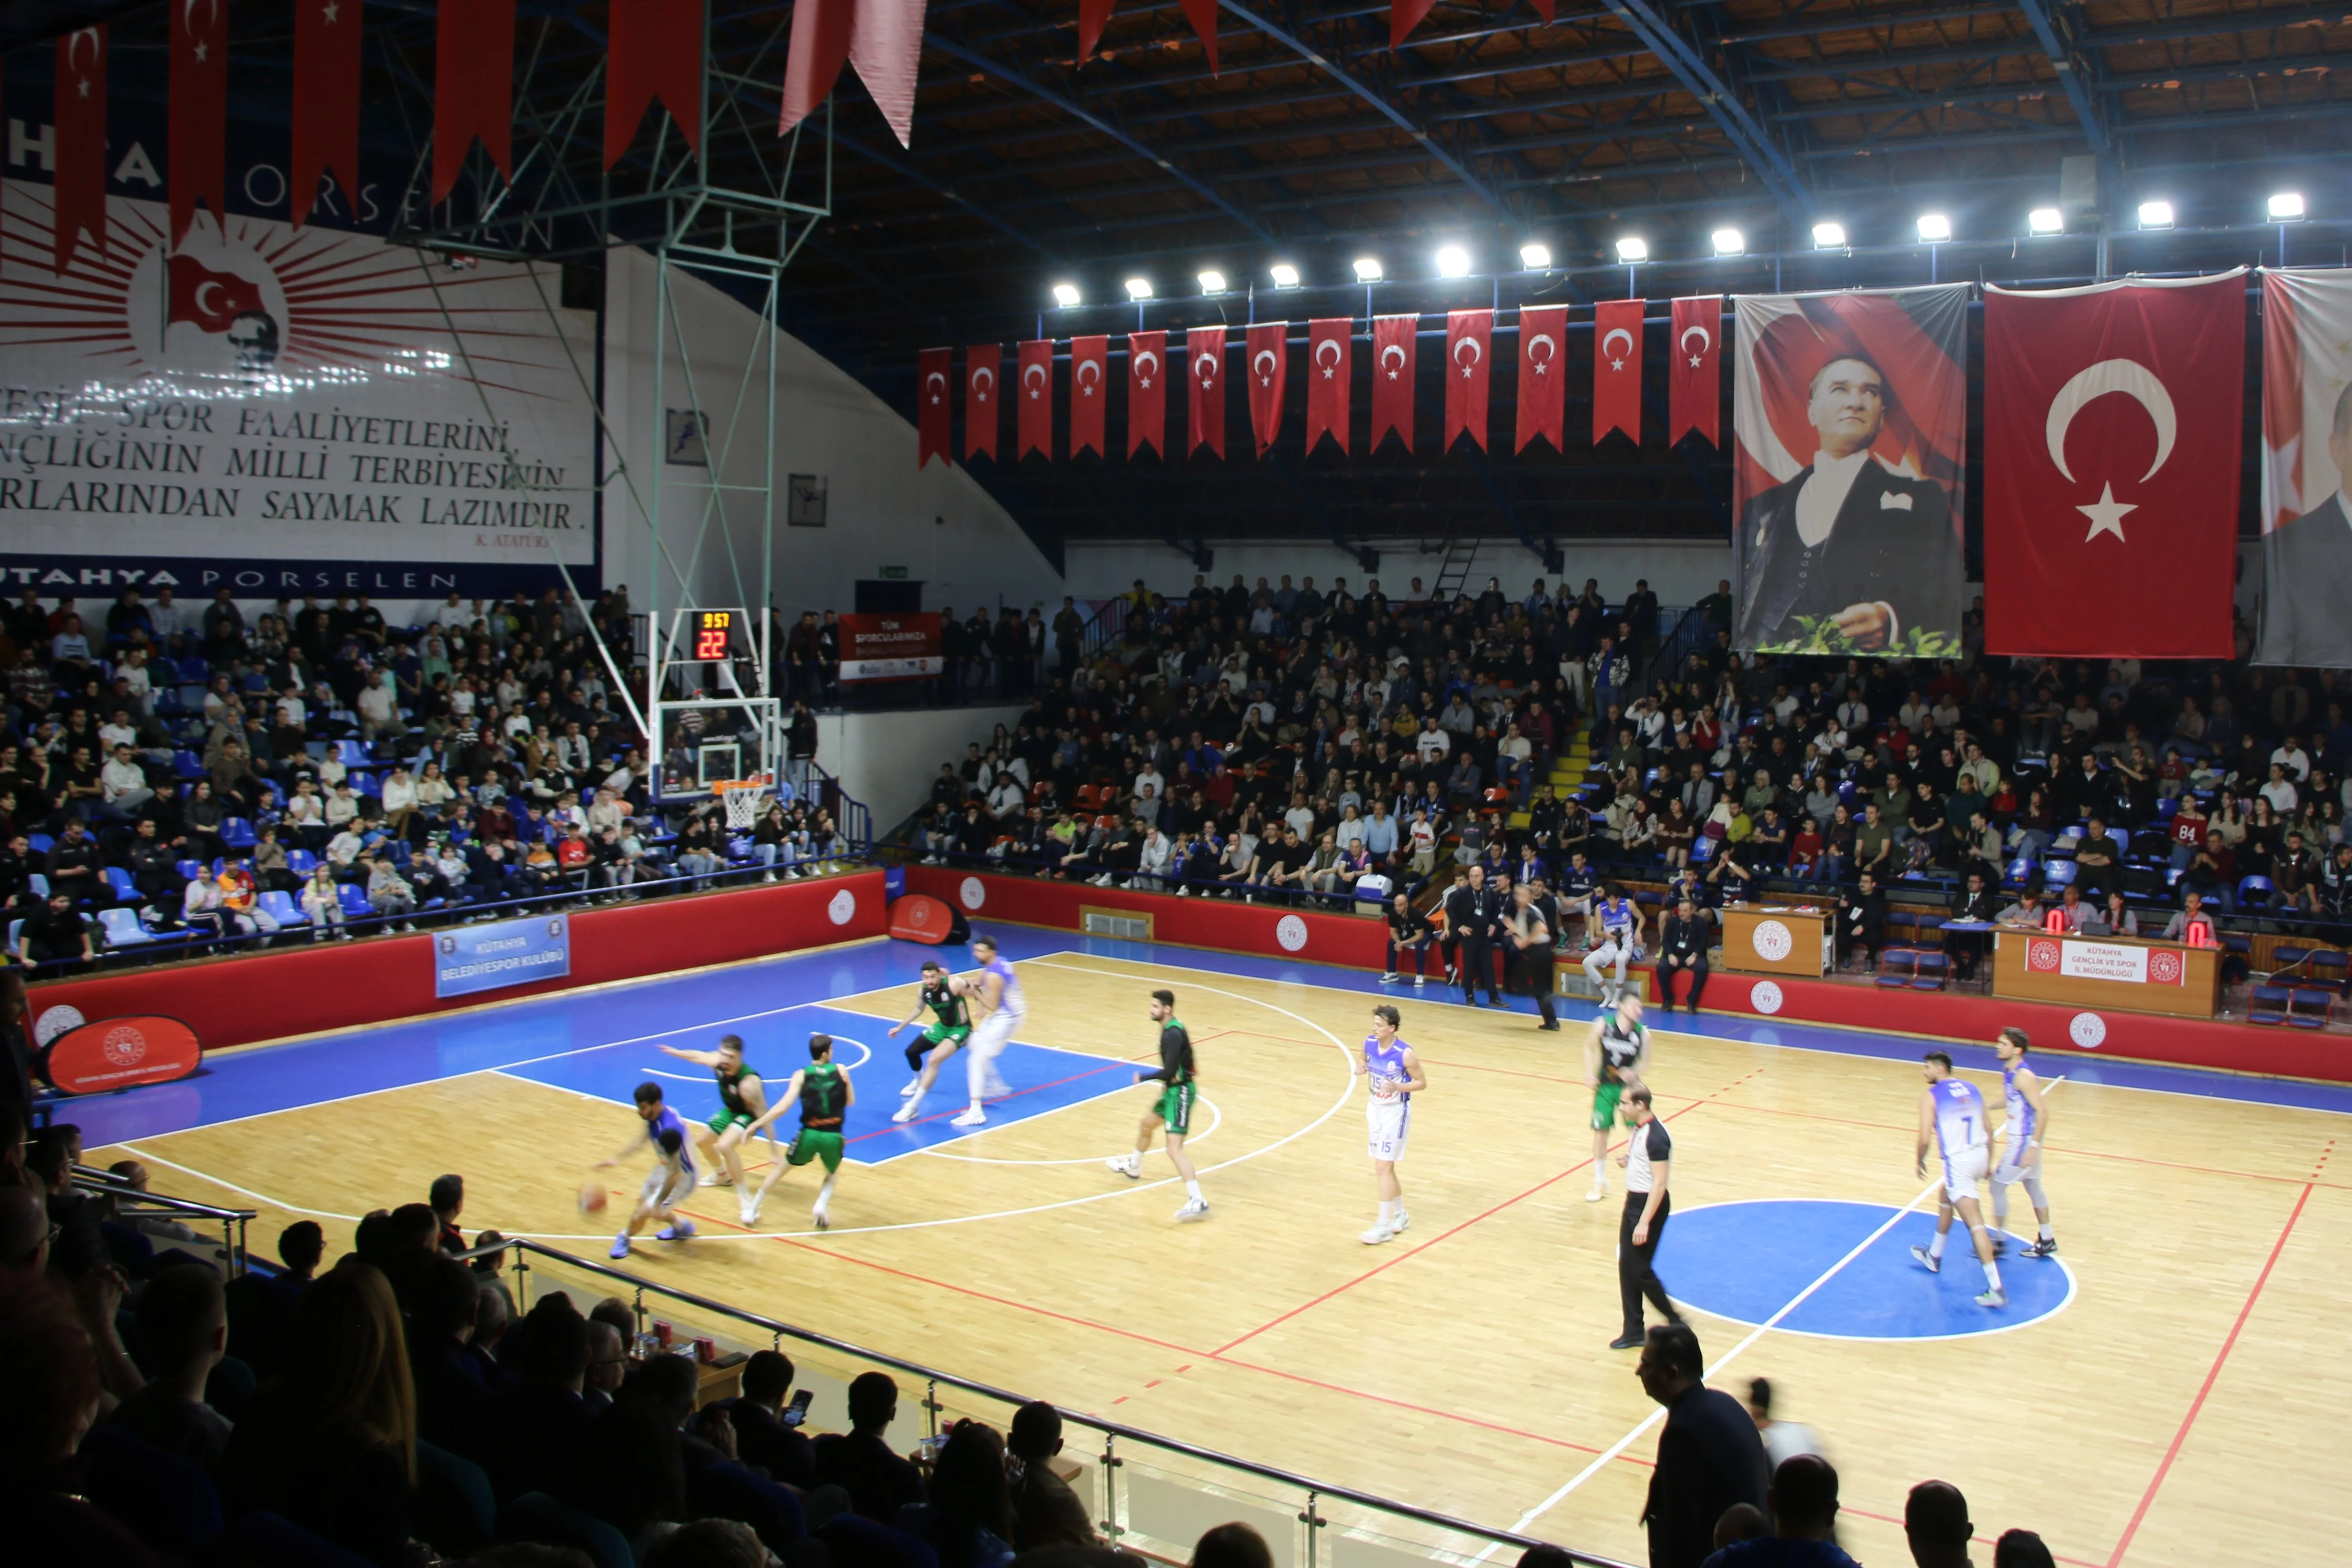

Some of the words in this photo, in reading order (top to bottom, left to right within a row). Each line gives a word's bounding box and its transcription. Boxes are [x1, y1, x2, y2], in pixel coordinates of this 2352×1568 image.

[118, 398, 214, 433] SPOR
[224, 441, 329, 480] MİLLİ
[0, 477, 241, 517] RLARINDAN
[262, 491, 401, 523] SAYMAK
[0, 567, 181, 586] TAHYA
[202, 571, 456, 587] PORSELEN
[881, 619, 899, 630] TÜM
[697, 630, 727, 658] 22
[855, 631, 927, 643] SPORCULARIMIZA
[2179, 825, 2195, 841] 84
[476, 936, 527, 954] KÜTAHYA
[2087, 946, 2122, 957] KÜTAHYA
[441, 957, 521, 981] BELEDİYESPOR
[521, 948, 565, 967] KULÜBÜ
[2071, 955, 2103, 965] GENÇLİK
[2116, 960, 2137, 968] SPOR
[2074, 965, 2081, 973] İL
[2083, 967, 2133, 978] MÜDÜRLÜĞÜ
[1372, 1075, 1381, 1090] 15
[1961, 1116, 1973, 1144] 7
[1381, 1140, 1392, 1153] 15
